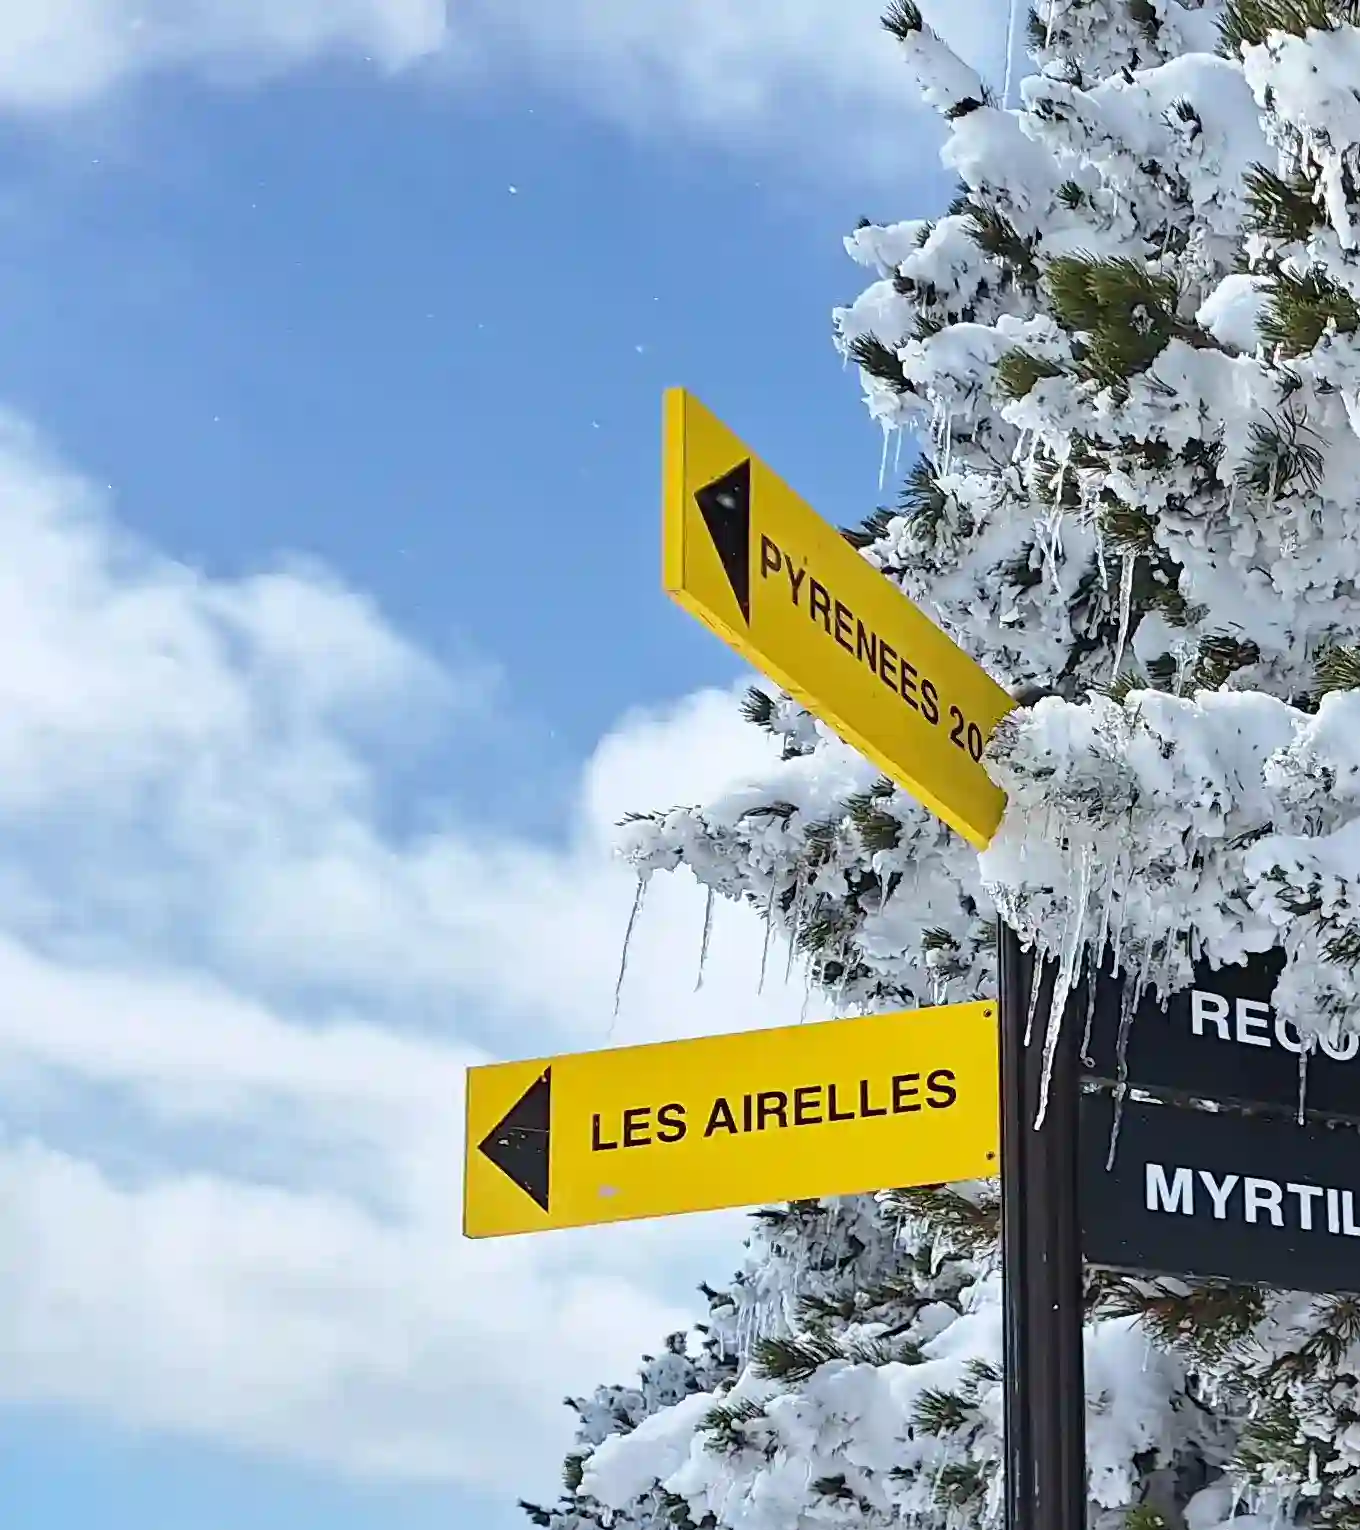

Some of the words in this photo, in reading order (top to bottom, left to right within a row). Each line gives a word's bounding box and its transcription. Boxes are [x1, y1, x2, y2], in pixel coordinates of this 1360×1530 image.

[759, 534, 939, 725] PYRENEES
[591, 1103, 687, 1152] LES
[703, 1069, 958, 1138] AIRELLES
